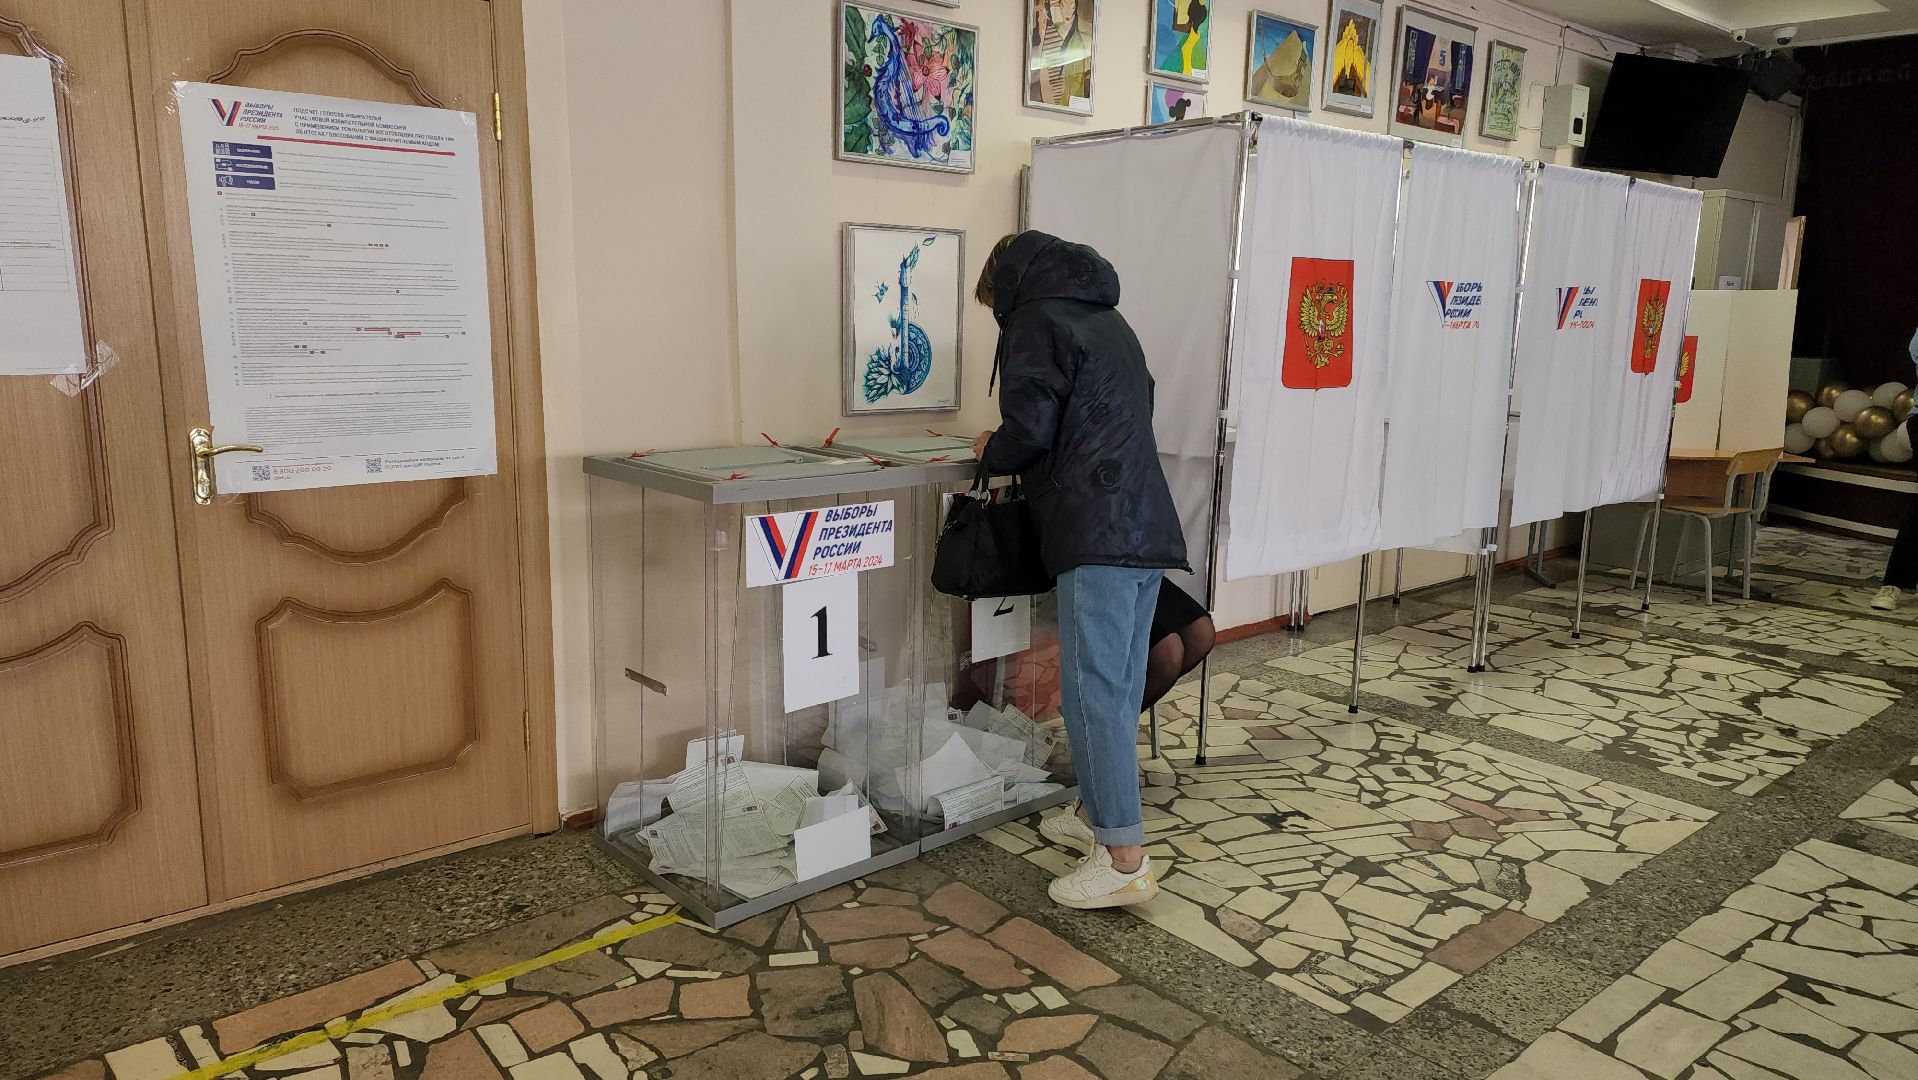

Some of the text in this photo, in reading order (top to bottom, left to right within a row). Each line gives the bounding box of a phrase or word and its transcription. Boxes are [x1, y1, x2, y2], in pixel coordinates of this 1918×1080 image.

[242, 109, 283, 118] ПРЕЗИДЕНТА
[245, 102, 274, 110] ВЫБОРЫ
[825, 504, 879, 523] ВЫБОРЫ
[818, 519, 893, 542] ПРЕЗИДЕНТА
[812, 540, 863, 561] РОССИИ
[833, 557, 862, 573] МАРТА
[863, 554, 883, 568] 2024
[810, 605, 833, 661] 1
